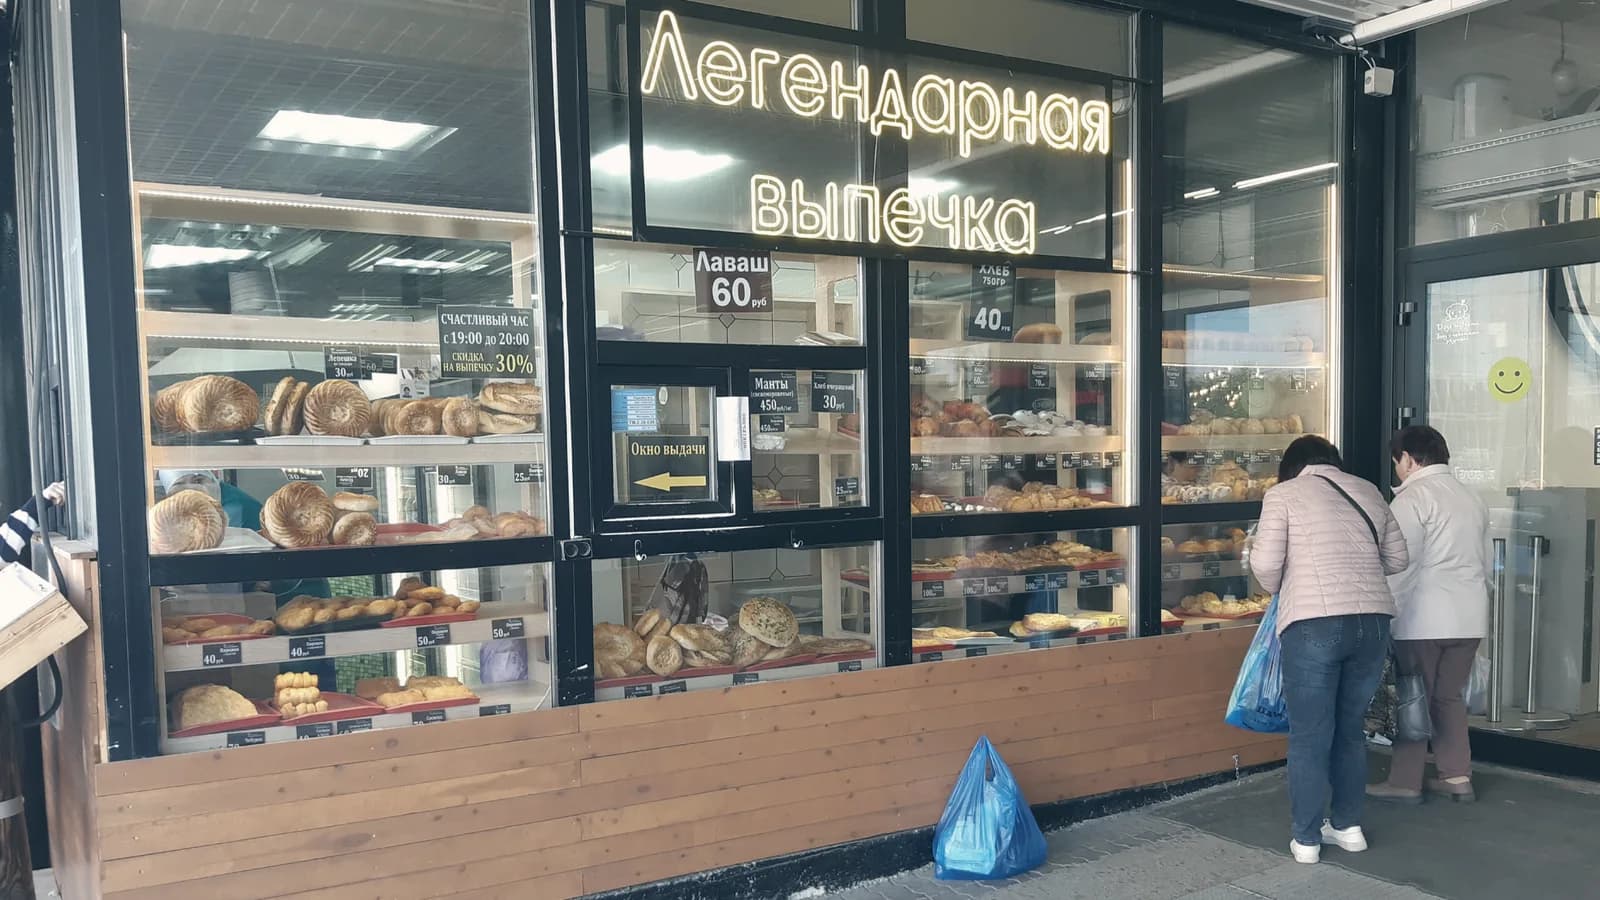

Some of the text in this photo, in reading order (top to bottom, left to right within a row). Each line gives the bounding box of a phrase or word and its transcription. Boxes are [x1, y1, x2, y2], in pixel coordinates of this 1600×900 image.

[640, 9, 1110, 158] Легендарная
[696, 251, 768, 272] Лаваш
[979, 264, 1010, 276] ХЛЕБ
[983, 276, 1006, 286] 750ГР
[712, 277, 767, 308] 60 руб
[441, 312, 529, 327] СЧАСТЛИВЫЙ ЧАС
[974, 307, 1001, 330] 40
[451, 331, 482, 345] 19:00
[484, 335, 497, 346] до
[498, 332, 530, 346] 20:00
[452, 352, 484, 362] СКИДКА
[443, 362, 494, 373] НА ВЫПЕЧКУ
[495, 353, 533, 374] 30%
[335, 367, 346, 377] 30
[755, 377, 788, 390] Манты
[760, 399, 777, 411] 450
[823, 395, 836, 409] 30
[631, 442, 706, 457] Окно выдачи
[439, 475, 448, 484] 30
[515, 473, 524, 481] 25
[493, 628, 503, 638] 50
[417, 636, 428, 646] 50
[291, 647, 302, 657] 40
[203, 654, 216, 664] 40
